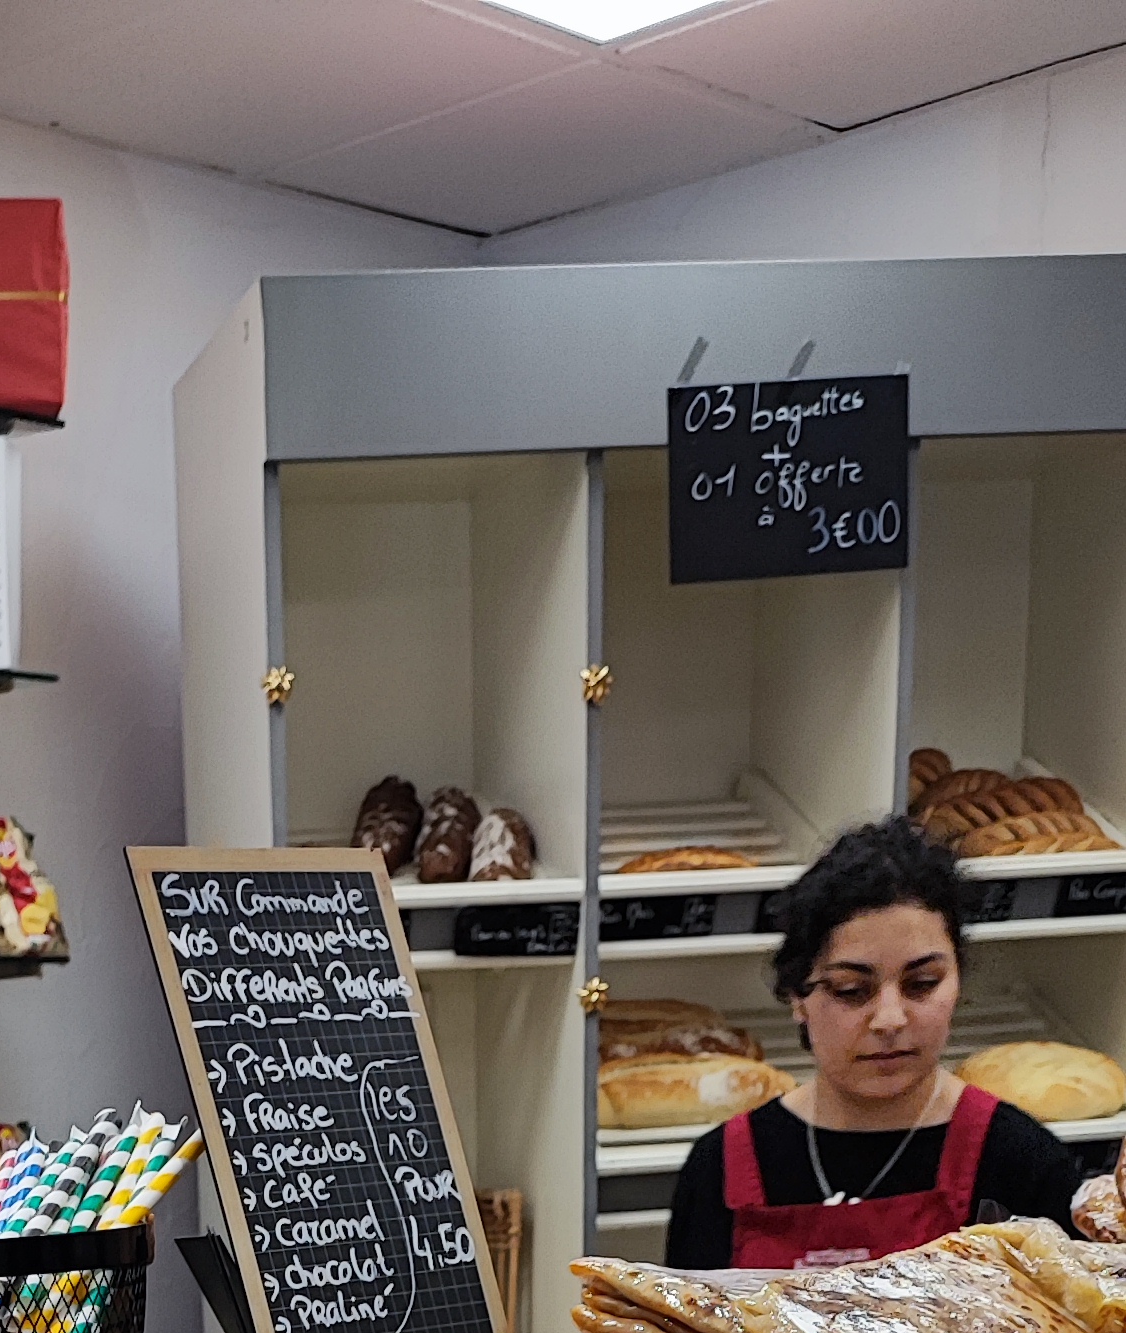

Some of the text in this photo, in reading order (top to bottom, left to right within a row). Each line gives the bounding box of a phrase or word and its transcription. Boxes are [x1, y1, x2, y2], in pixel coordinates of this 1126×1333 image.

[685, 382, 864, 447] 03 baguettes
[691, 463, 737, 500] 01
[236, 878, 369, 917] Commande
[168, 916, 389, 968] Vos Chouquettes
[227, 1038, 358, 1086] Pistache
[388, 1128, 428, 1161] 10
[275, 1199, 385, 1247] Caramel
